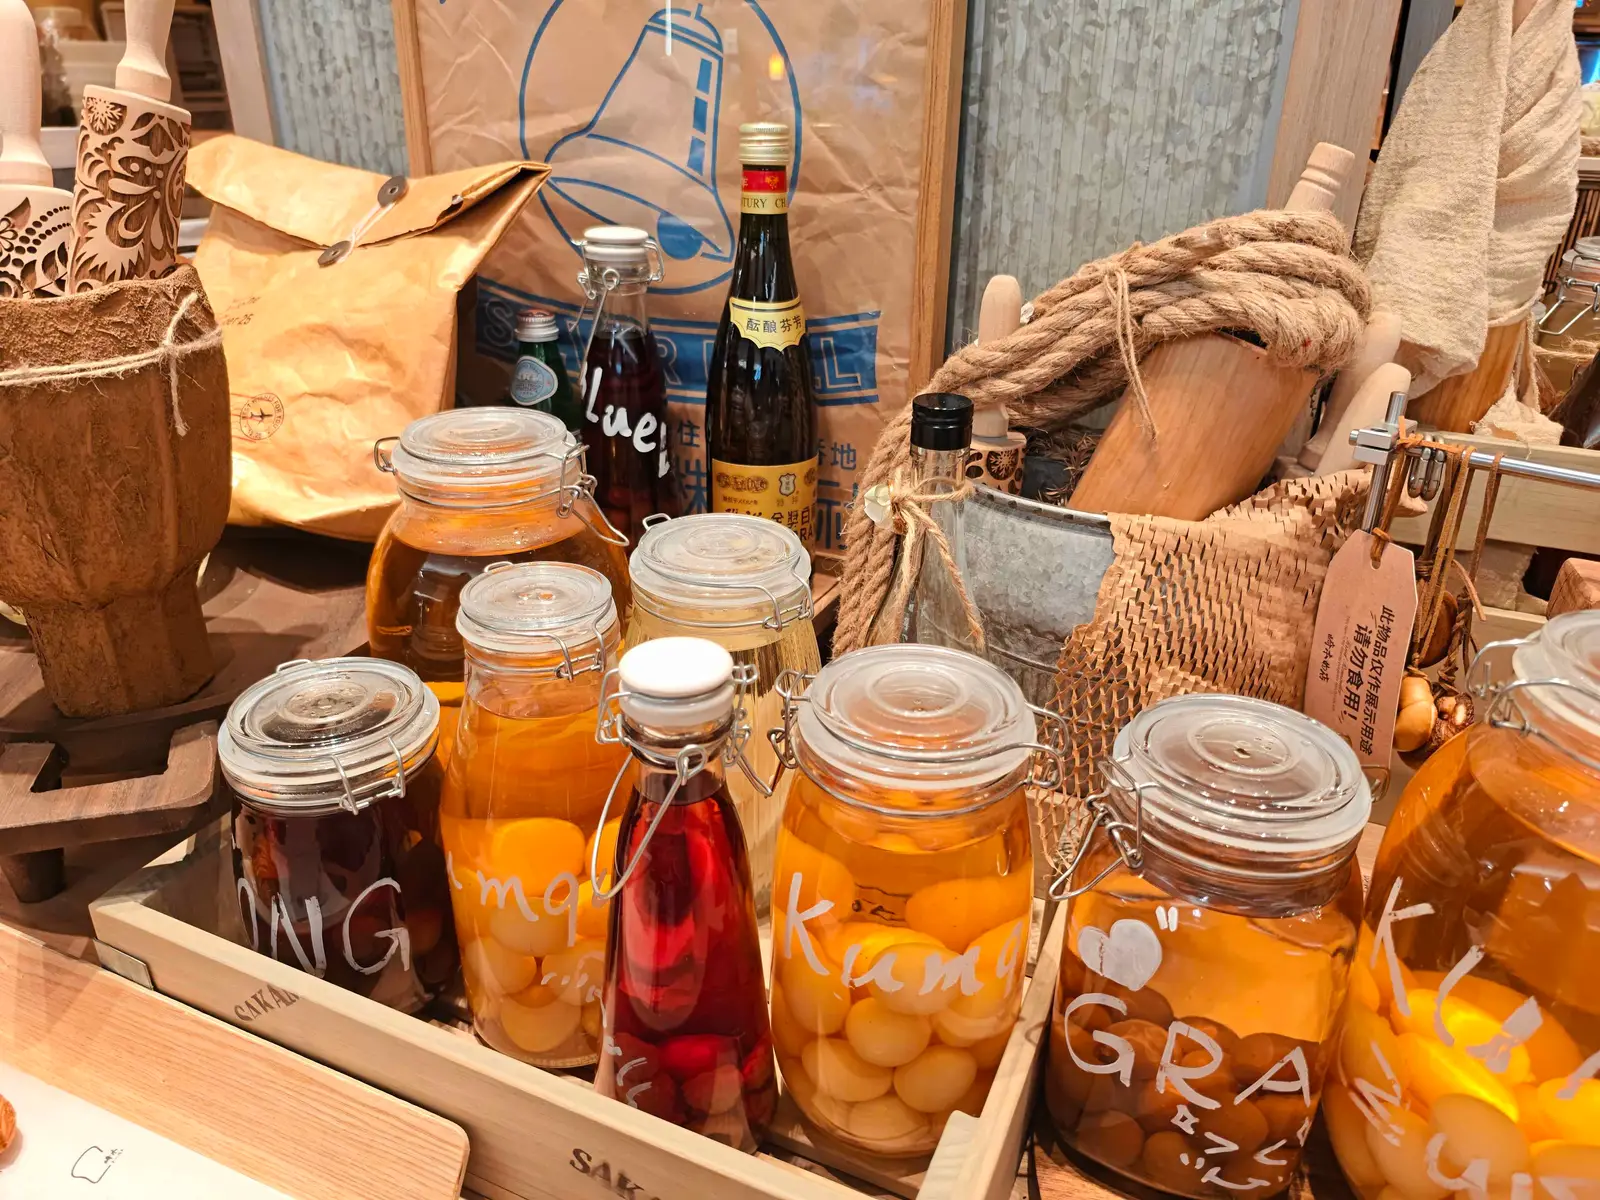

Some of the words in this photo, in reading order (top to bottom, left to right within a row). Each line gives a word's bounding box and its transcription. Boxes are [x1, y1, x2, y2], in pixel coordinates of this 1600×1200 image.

[746, 315, 802, 333] 酝酿芬芳
[1359, 604, 1395, 756] 此物品仅作展示用途
